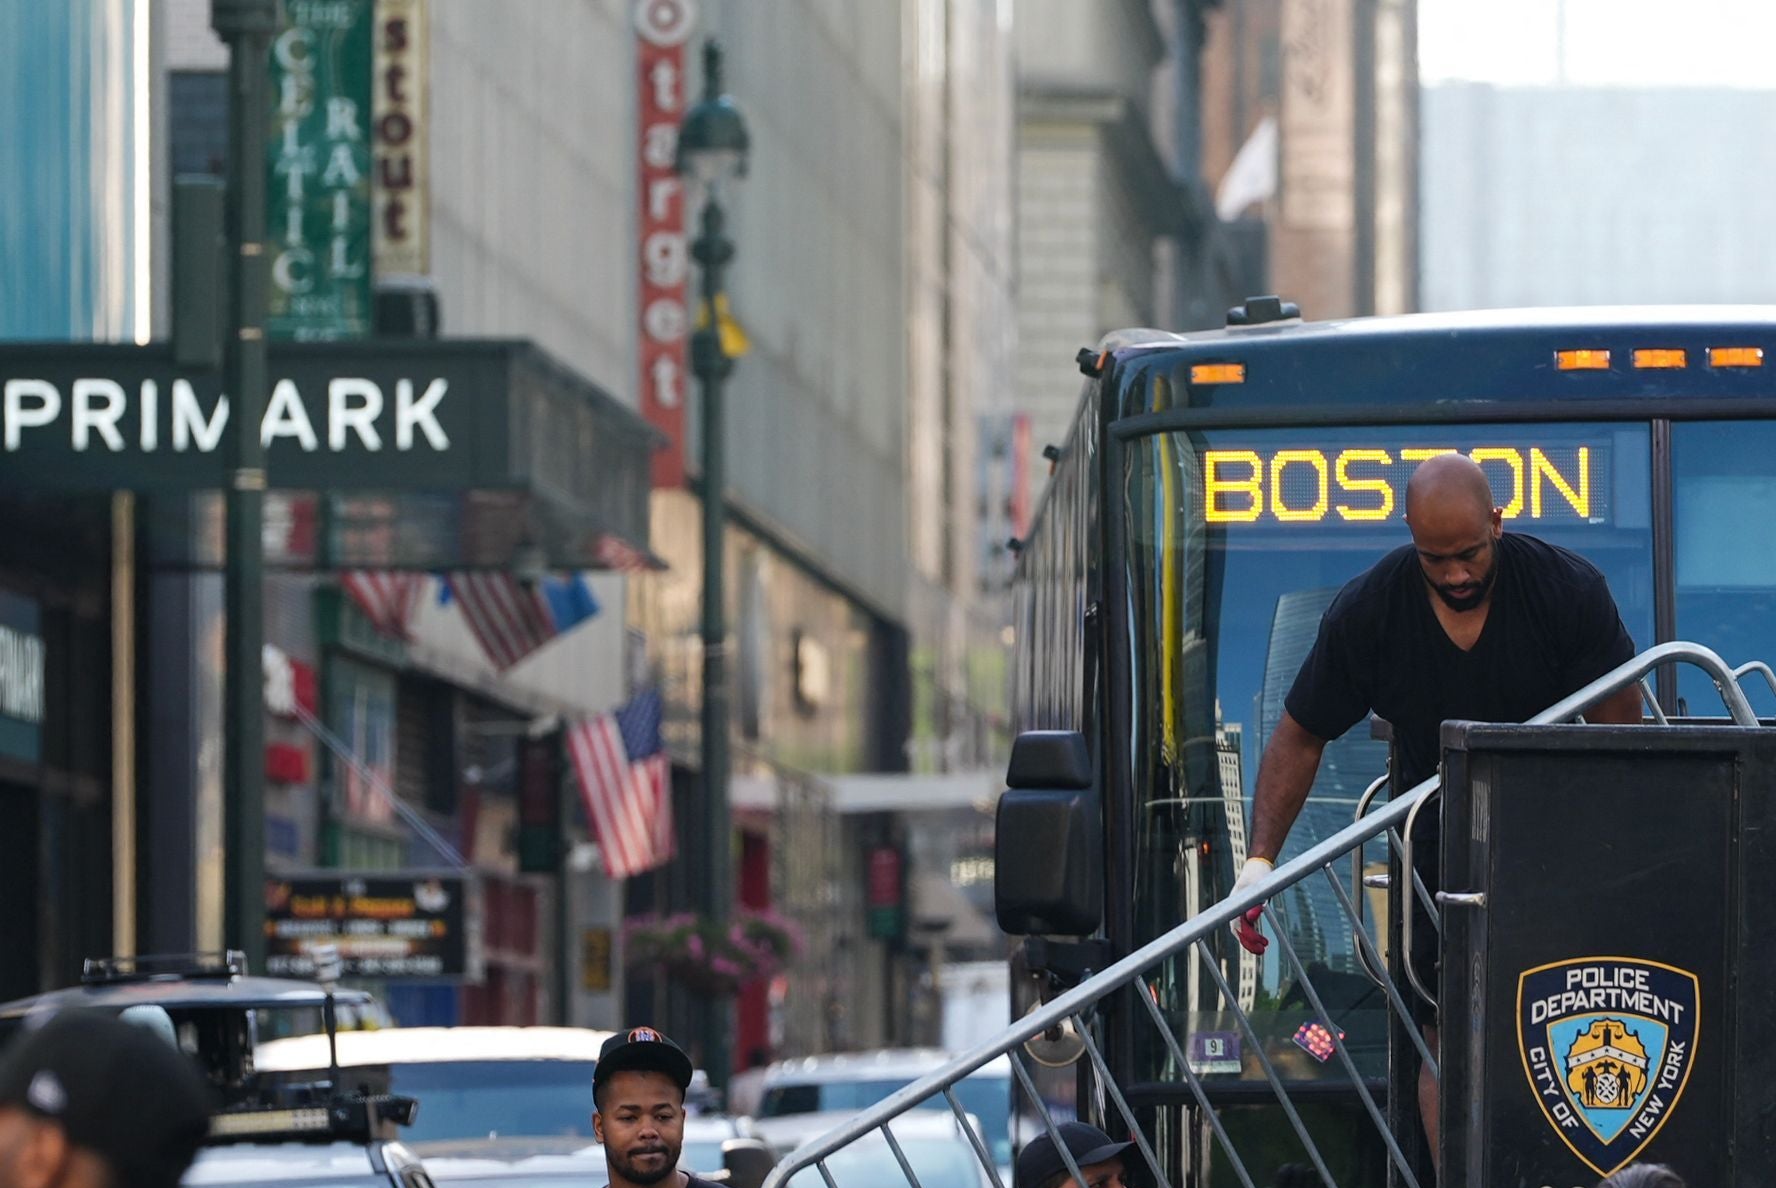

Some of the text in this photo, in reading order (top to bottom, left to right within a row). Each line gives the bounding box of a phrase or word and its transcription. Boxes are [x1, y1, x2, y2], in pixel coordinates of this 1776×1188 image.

[273, 27, 316, 293] CELTIC
[322, 97, 363, 278] RAIL
[381, 19, 411, 242] stout
[643, 59, 688, 409] target
[4, 378, 450, 452] PRIMARK
[1530, 988, 1684, 1025] DEPARTMENT
[1566, 967, 1650, 991] POLICE
[1530, 1040, 1686, 1139] CITY OF NEW YORK
